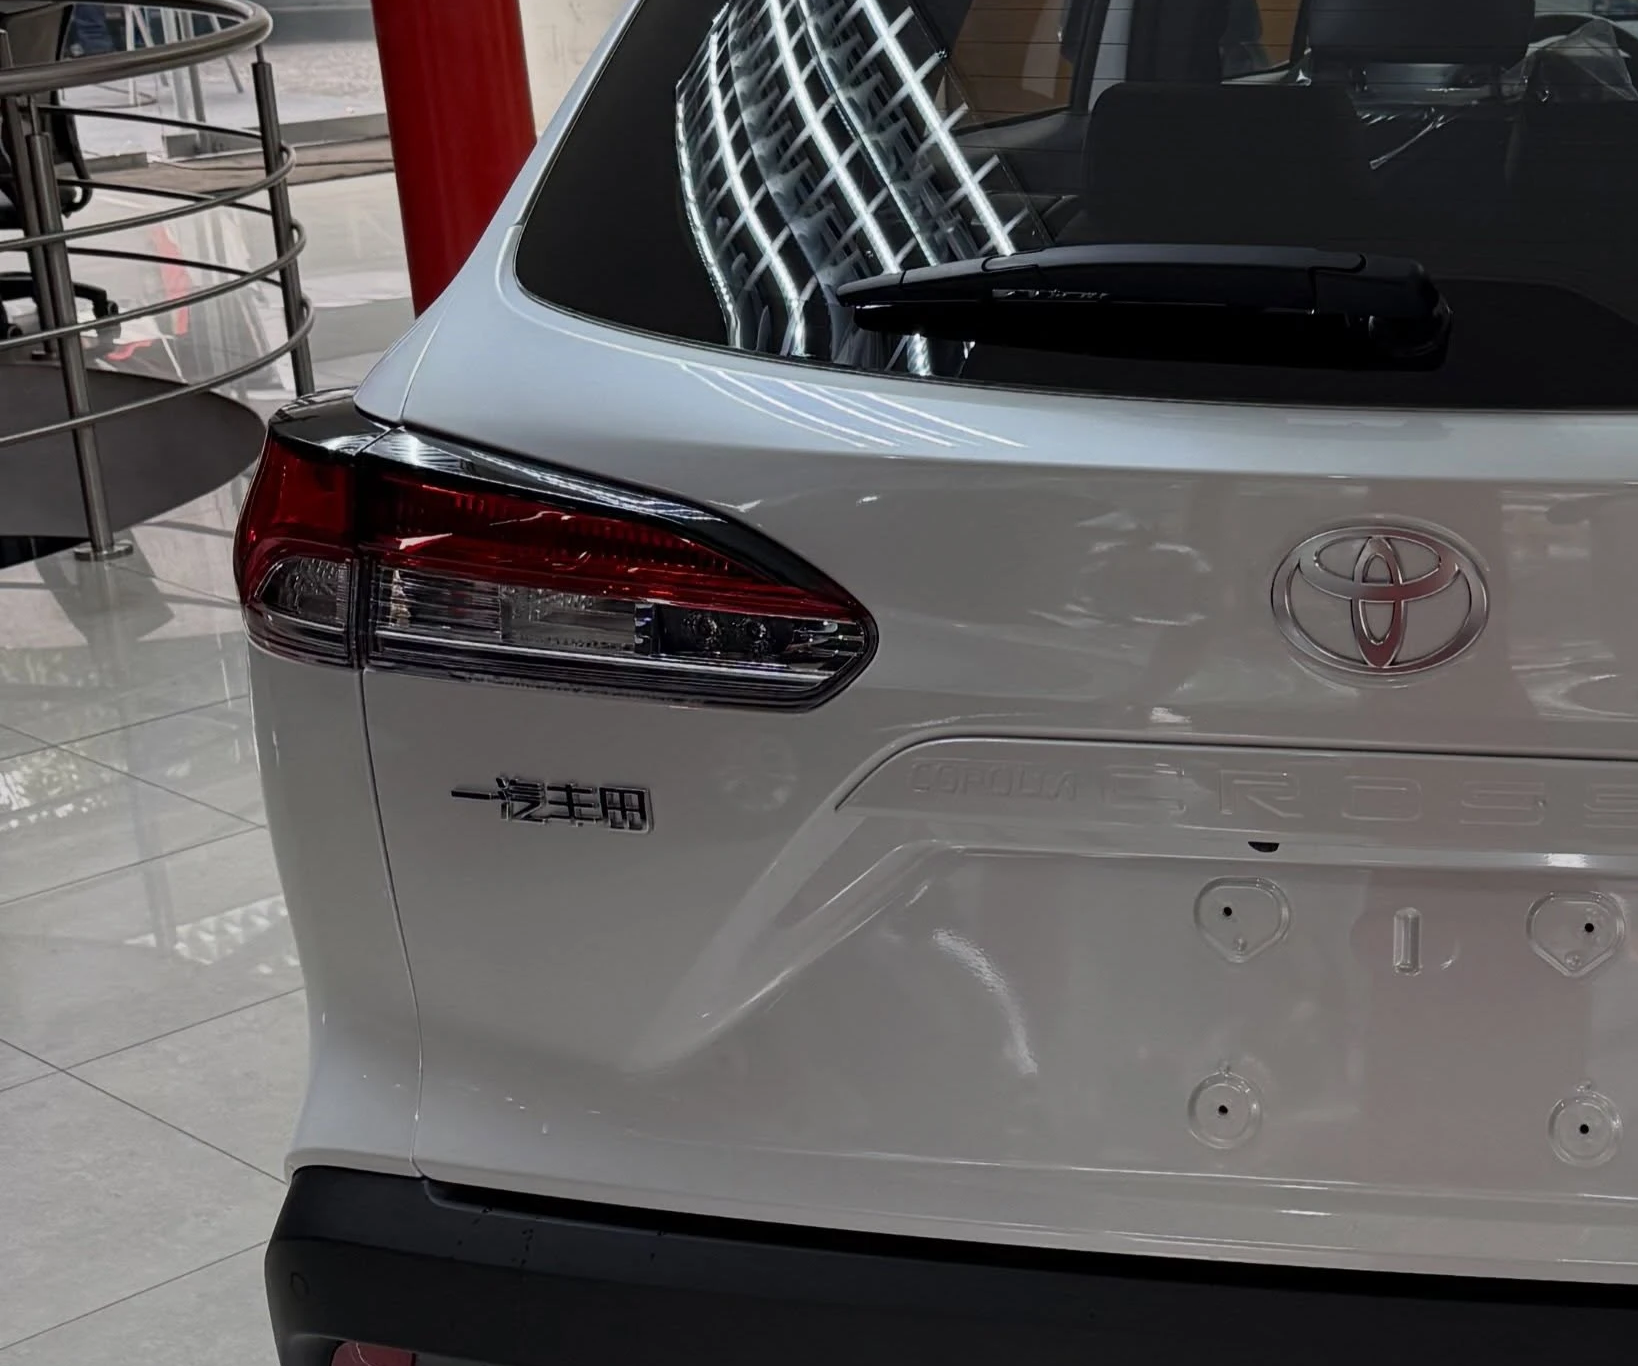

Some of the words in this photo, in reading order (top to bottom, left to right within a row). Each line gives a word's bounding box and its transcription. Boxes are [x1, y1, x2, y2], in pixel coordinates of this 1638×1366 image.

[450, 775, 654, 834] 一汽丰田
[909, 761, 1079, 804] COROLLA
